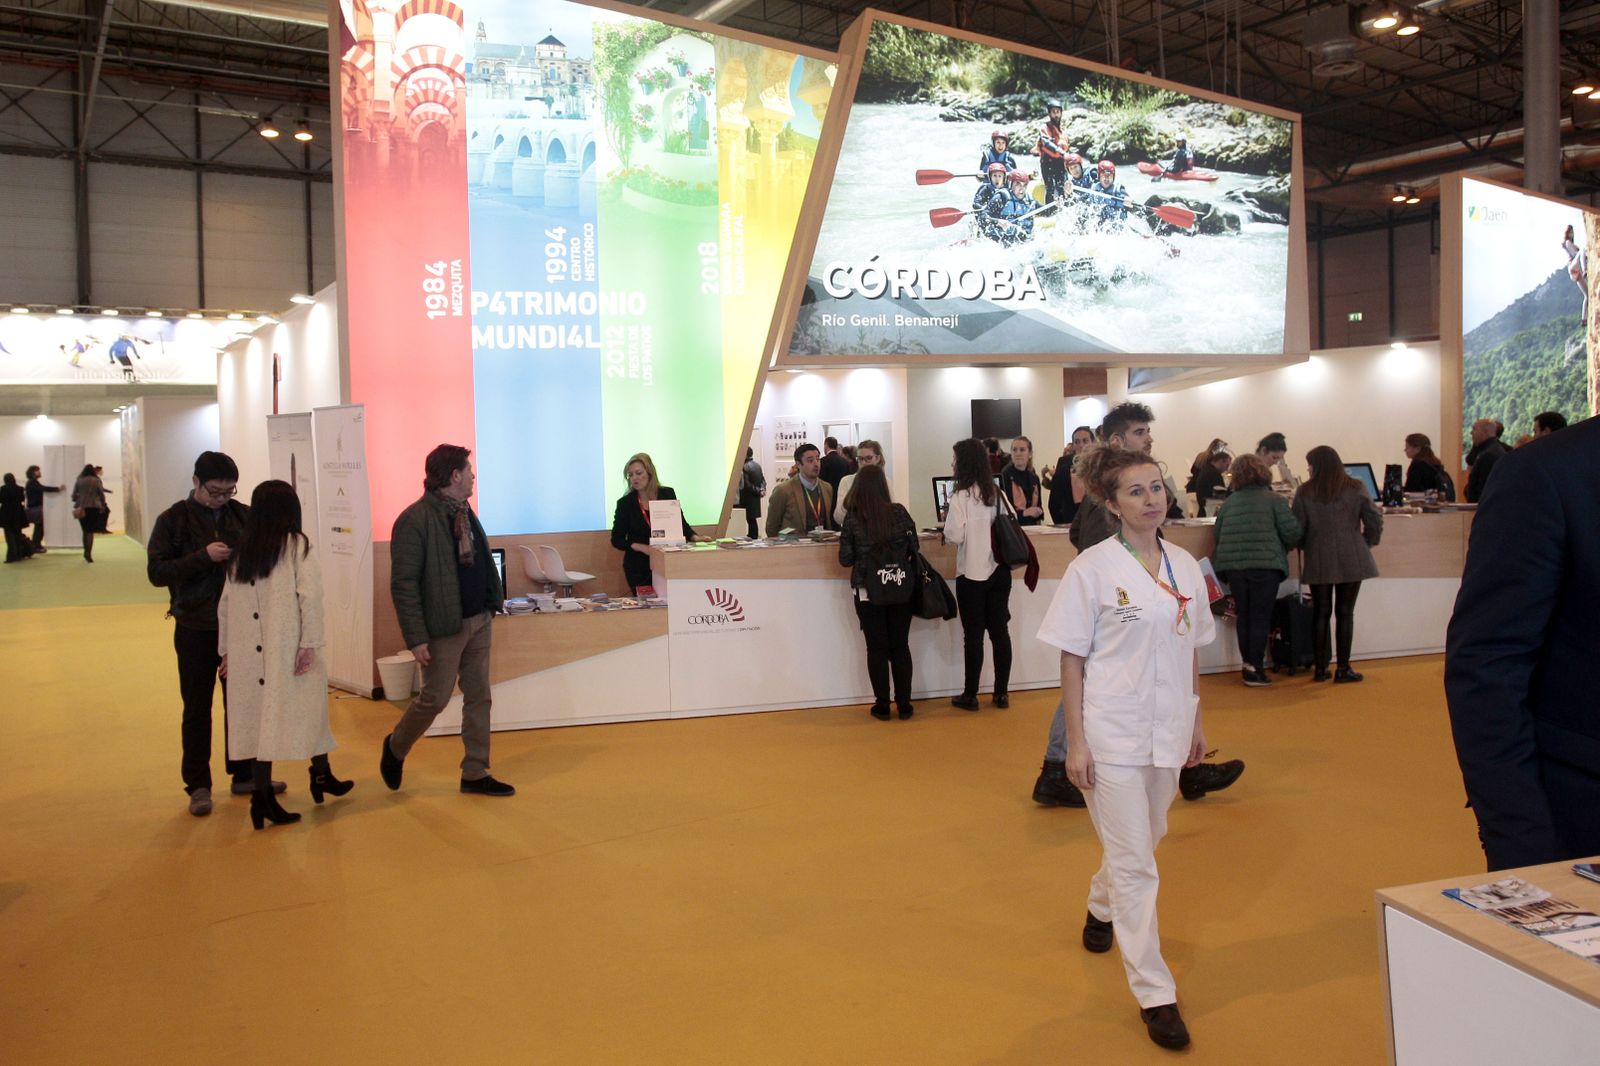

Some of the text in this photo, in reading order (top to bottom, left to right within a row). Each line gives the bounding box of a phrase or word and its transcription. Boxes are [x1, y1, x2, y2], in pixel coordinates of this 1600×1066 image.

[545, 226, 567, 284] 1994
[570, 237, 582, 282] CENTRO
[583, 222, 595, 282] HISTÓRICO
[698, 241, 719, 295] 2018
[822, 255, 1046, 300] CÓRDOBA
[422, 260, 448, 320] 1984
[451, 258, 463, 317] MEZQUITA
[471, 291, 646, 315] P4TRIMONIO
[472, 324, 600, 350] MUNDI4L
[822, 313, 960, 329] Río Genil. Benamejí
[606, 325, 625, 378] 2012
